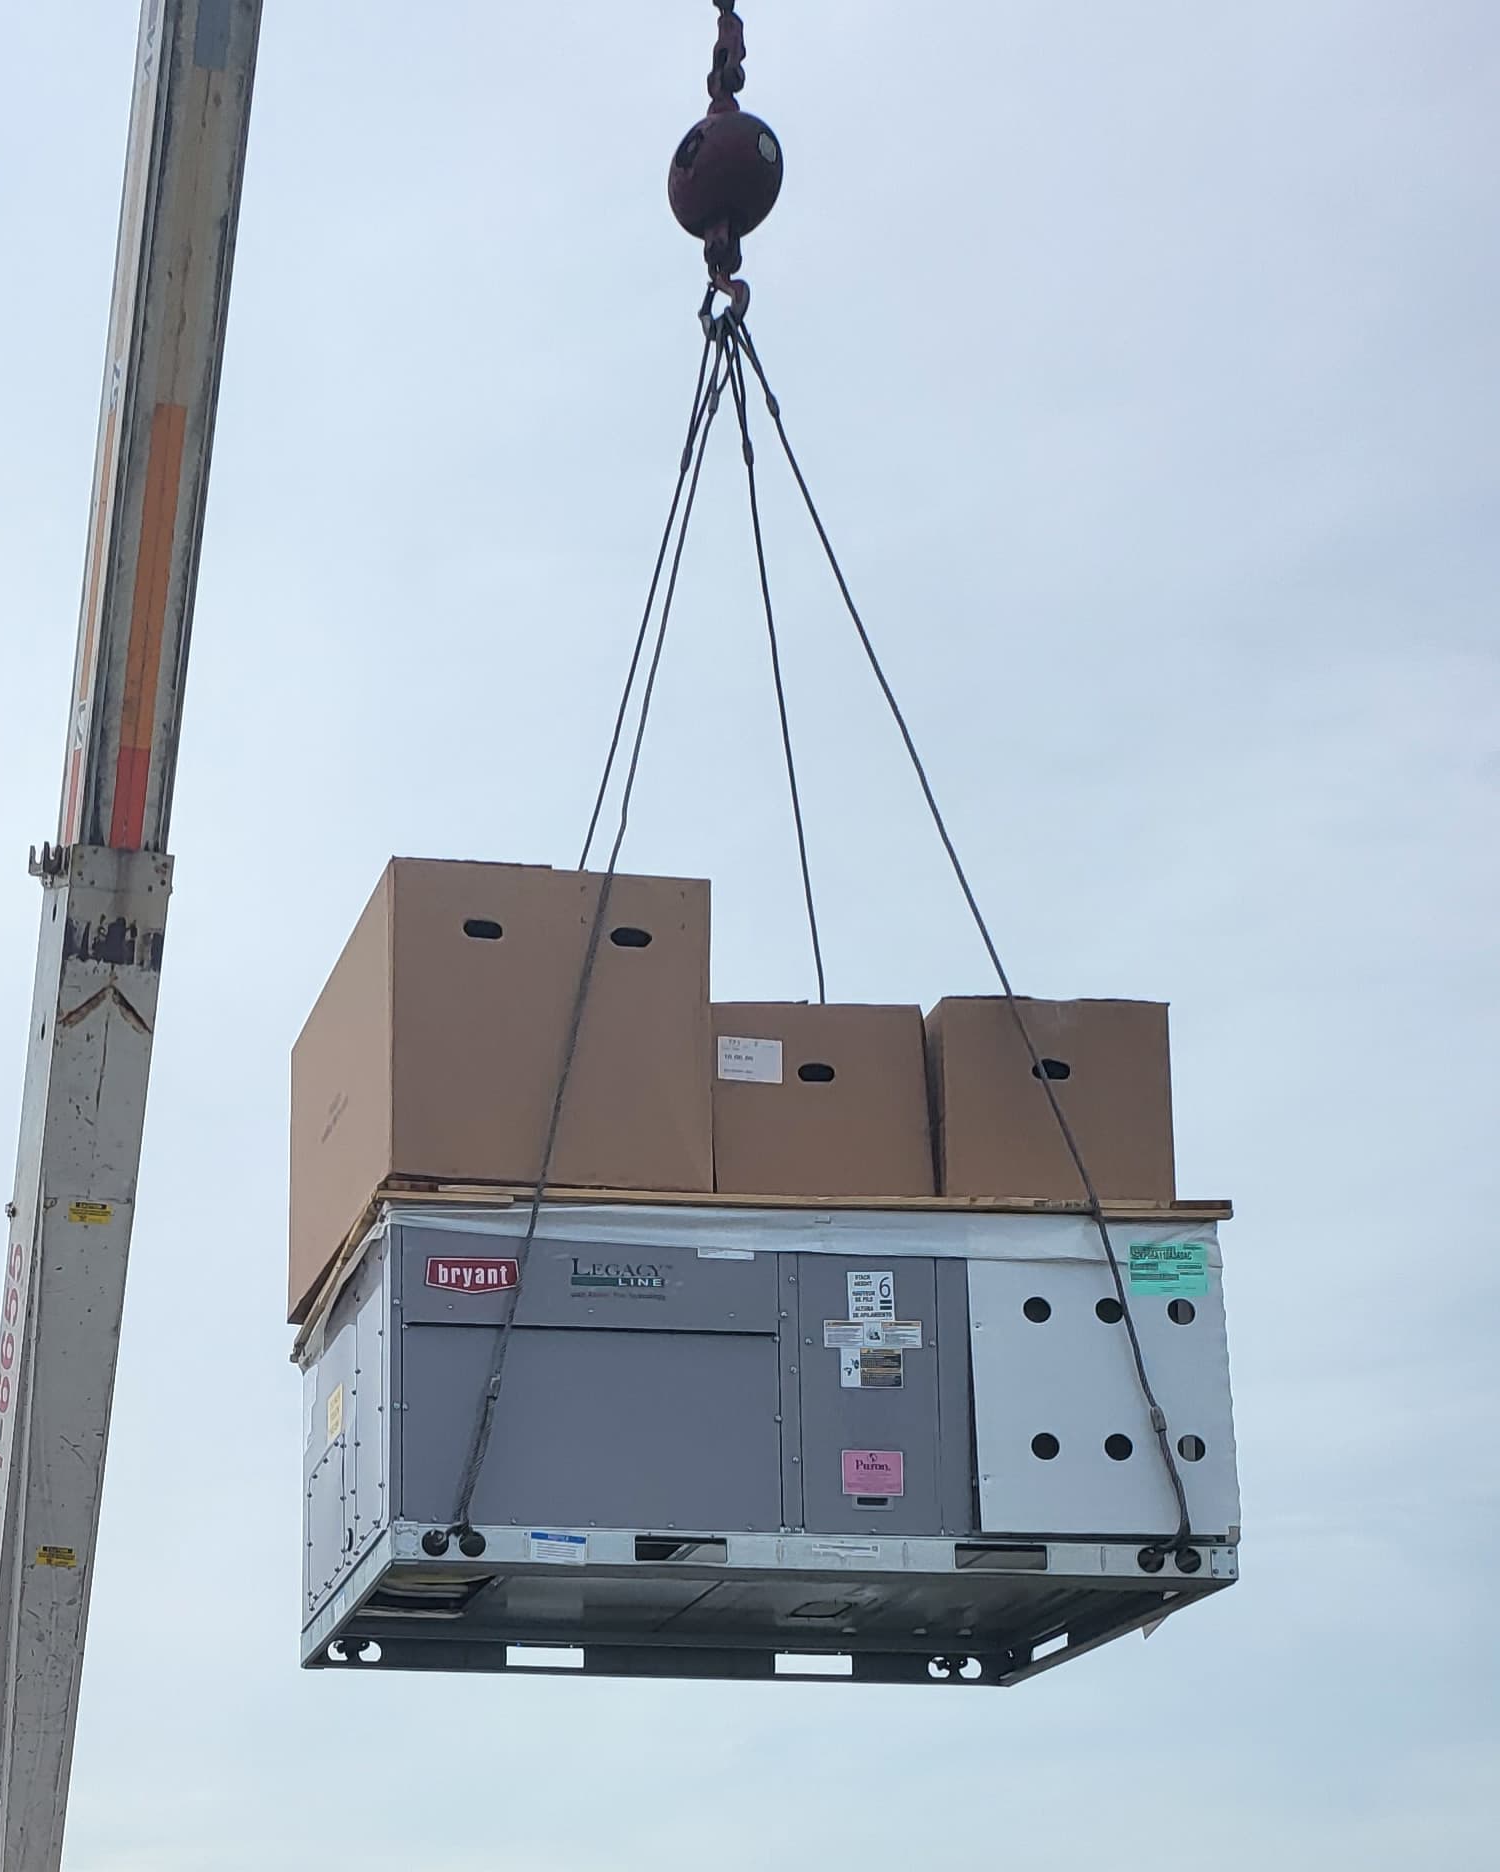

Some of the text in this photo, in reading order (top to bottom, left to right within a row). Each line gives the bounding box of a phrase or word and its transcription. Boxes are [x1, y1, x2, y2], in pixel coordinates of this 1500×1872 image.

[438, 1263, 508, 1288] bryant
[571, 1257, 662, 1277] LEGACY
[618, 1277, 663, 1287] LINE
[879, 1276, 891, 1298] 6
